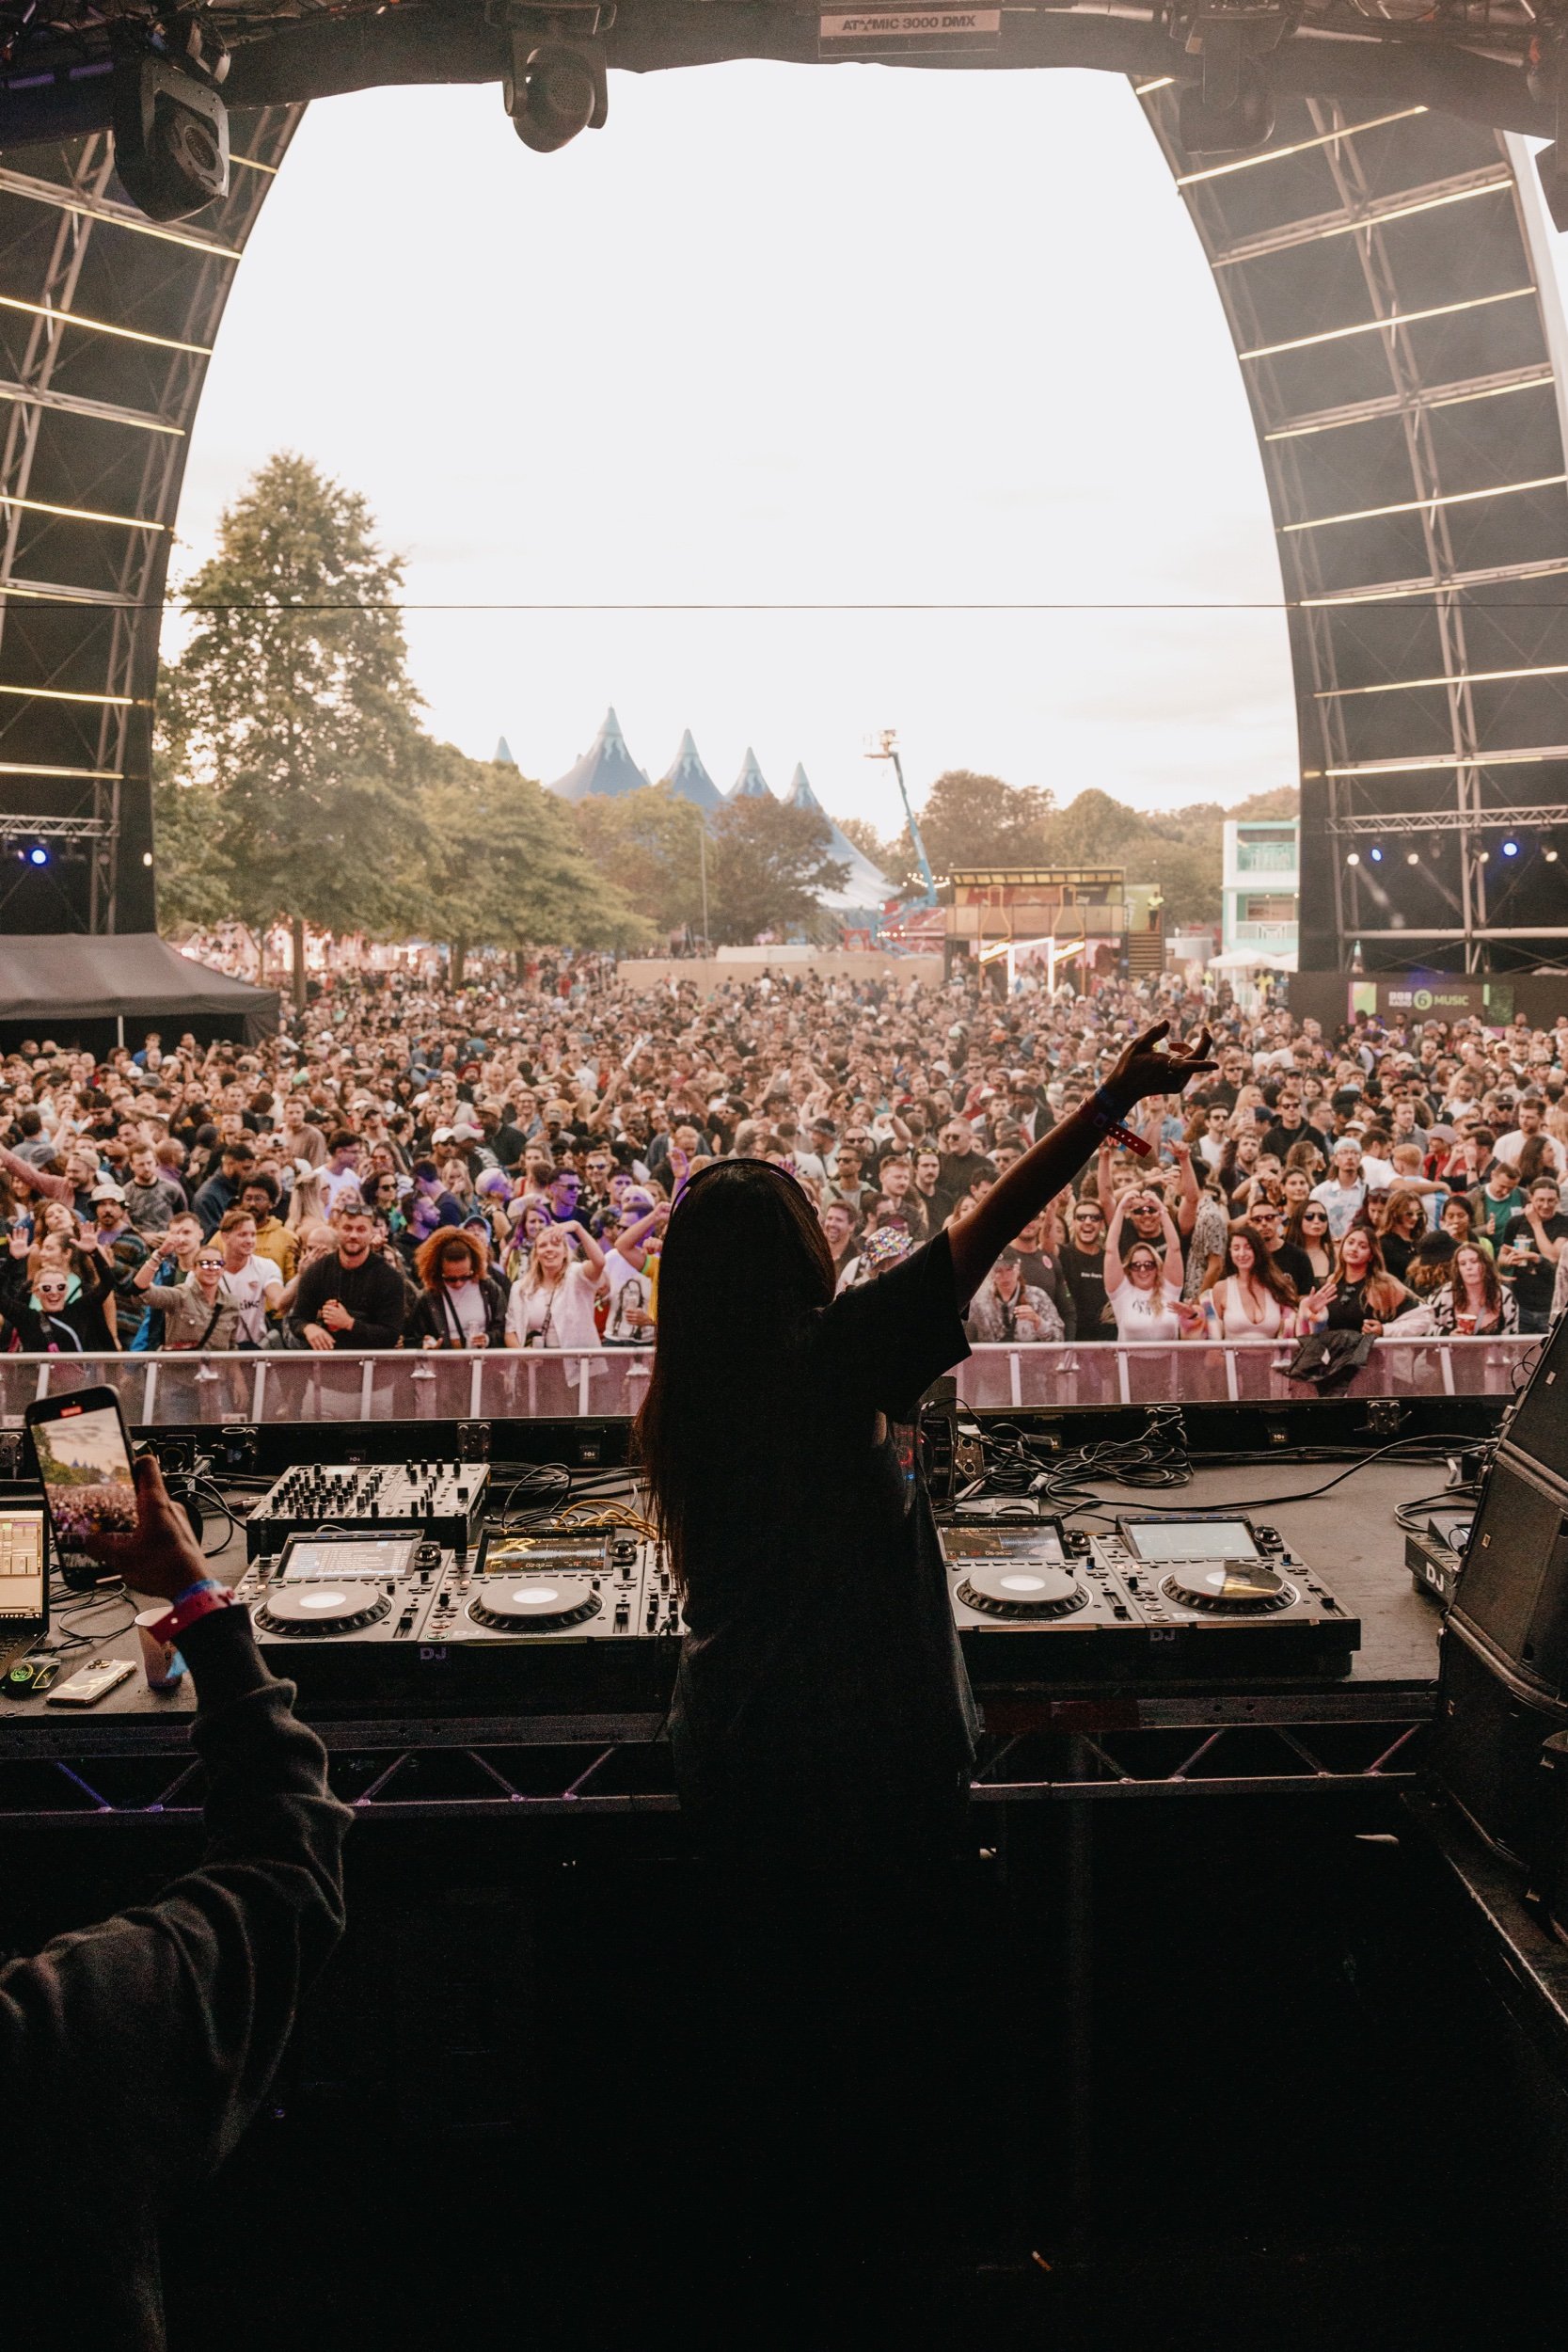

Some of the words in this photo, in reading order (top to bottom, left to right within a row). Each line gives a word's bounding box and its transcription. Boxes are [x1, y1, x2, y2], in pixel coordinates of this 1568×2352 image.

[903, 17, 939, 29] 3000
[942, 15, 976, 27] DMX
[1433, 994, 1470, 1006] MUSIC
[1426, 1561, 1445, 1592] DJ
[1148, 1629, 1176, 1642] DJ
[420, 1646, 448, 1661] DJ
